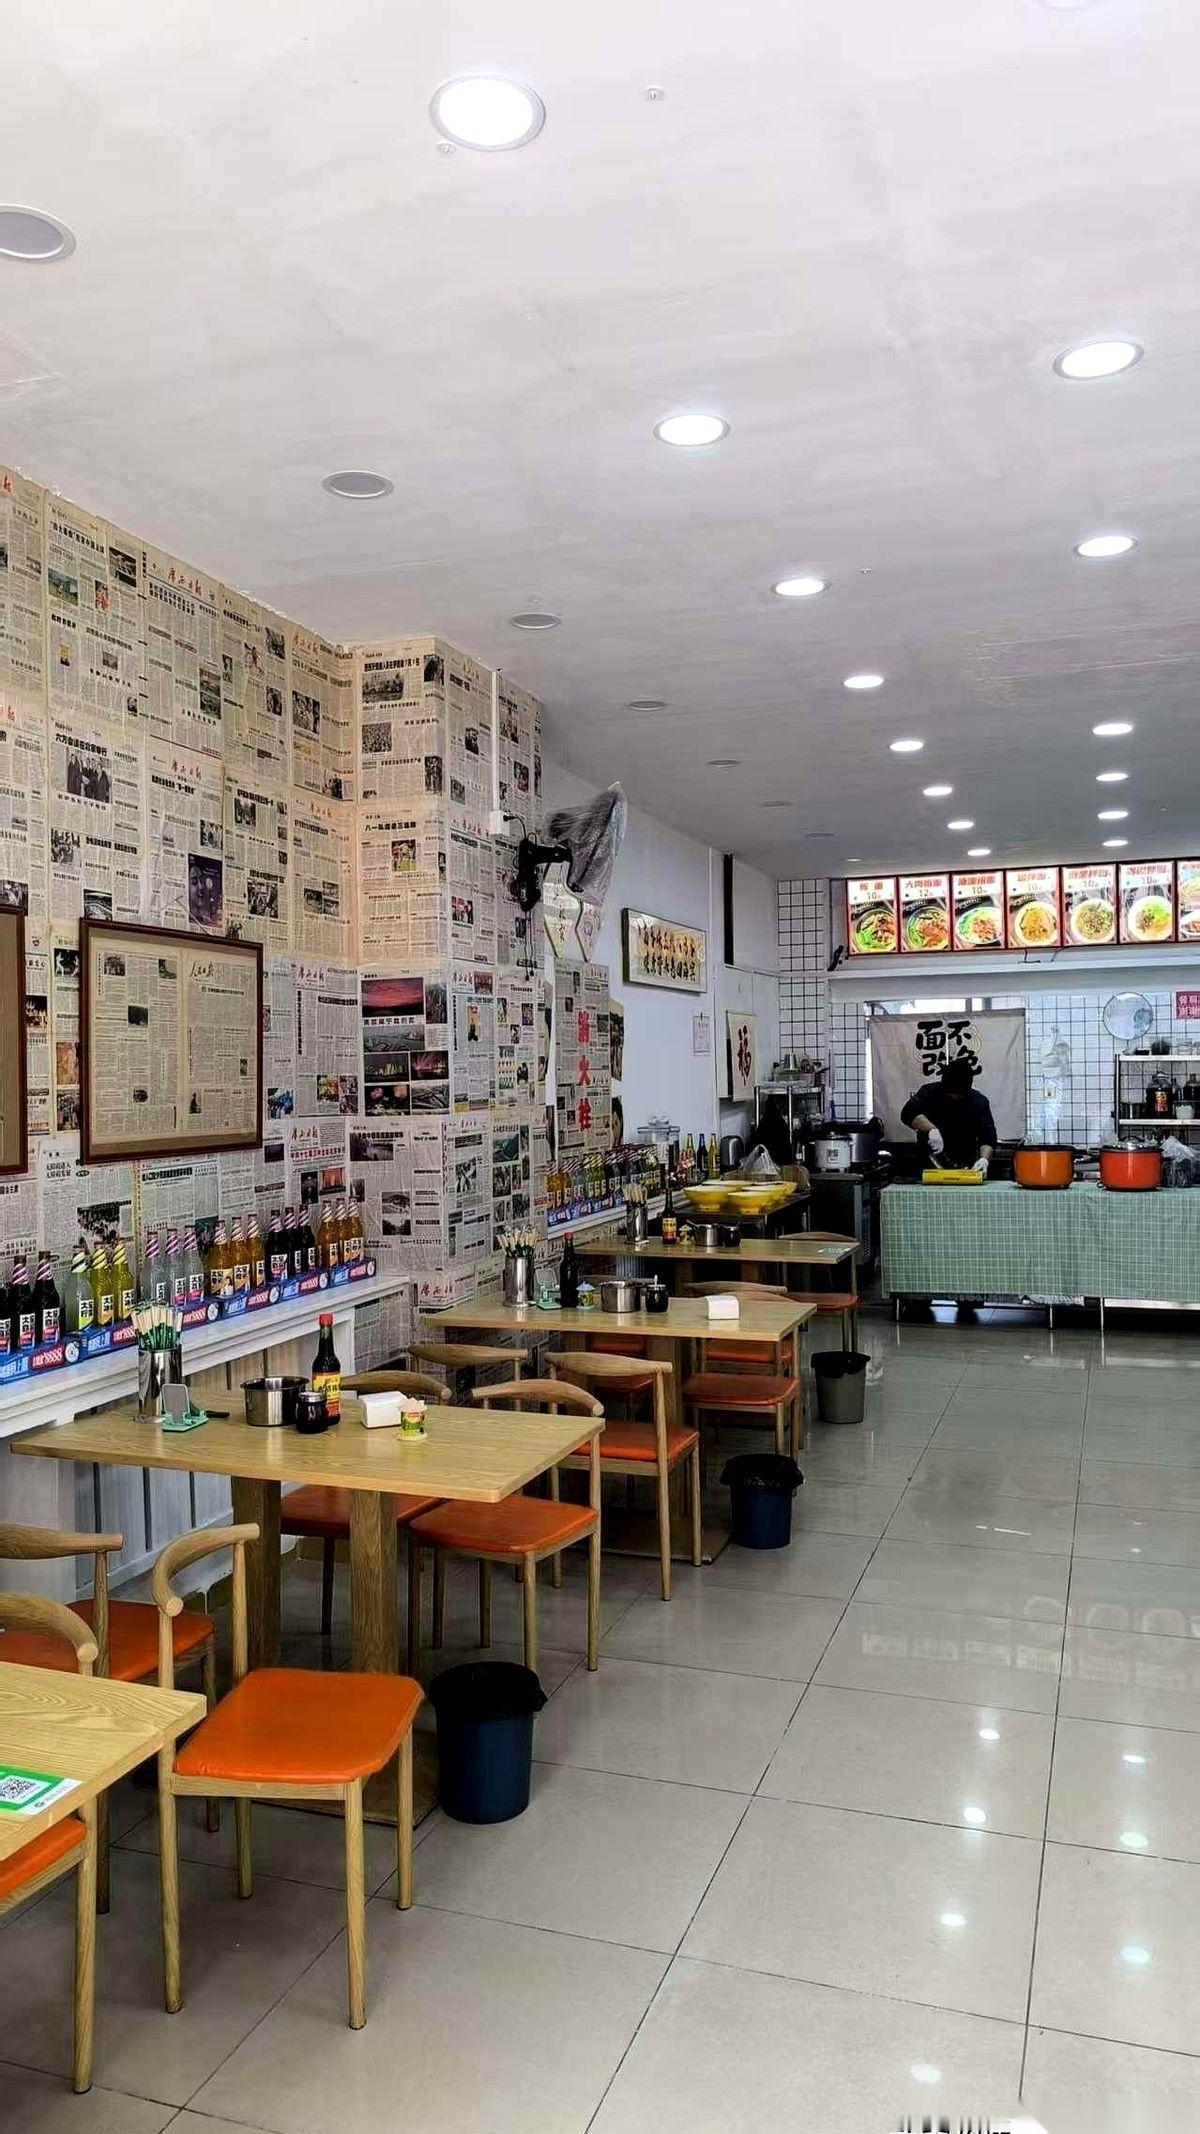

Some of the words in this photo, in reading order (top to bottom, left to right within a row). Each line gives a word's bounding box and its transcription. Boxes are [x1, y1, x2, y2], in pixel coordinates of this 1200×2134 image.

[916, 1020, 972, 1051] 面不
[737, 1024, 752, 1087] 福
[921, 1045, 983, 1077] 改色
